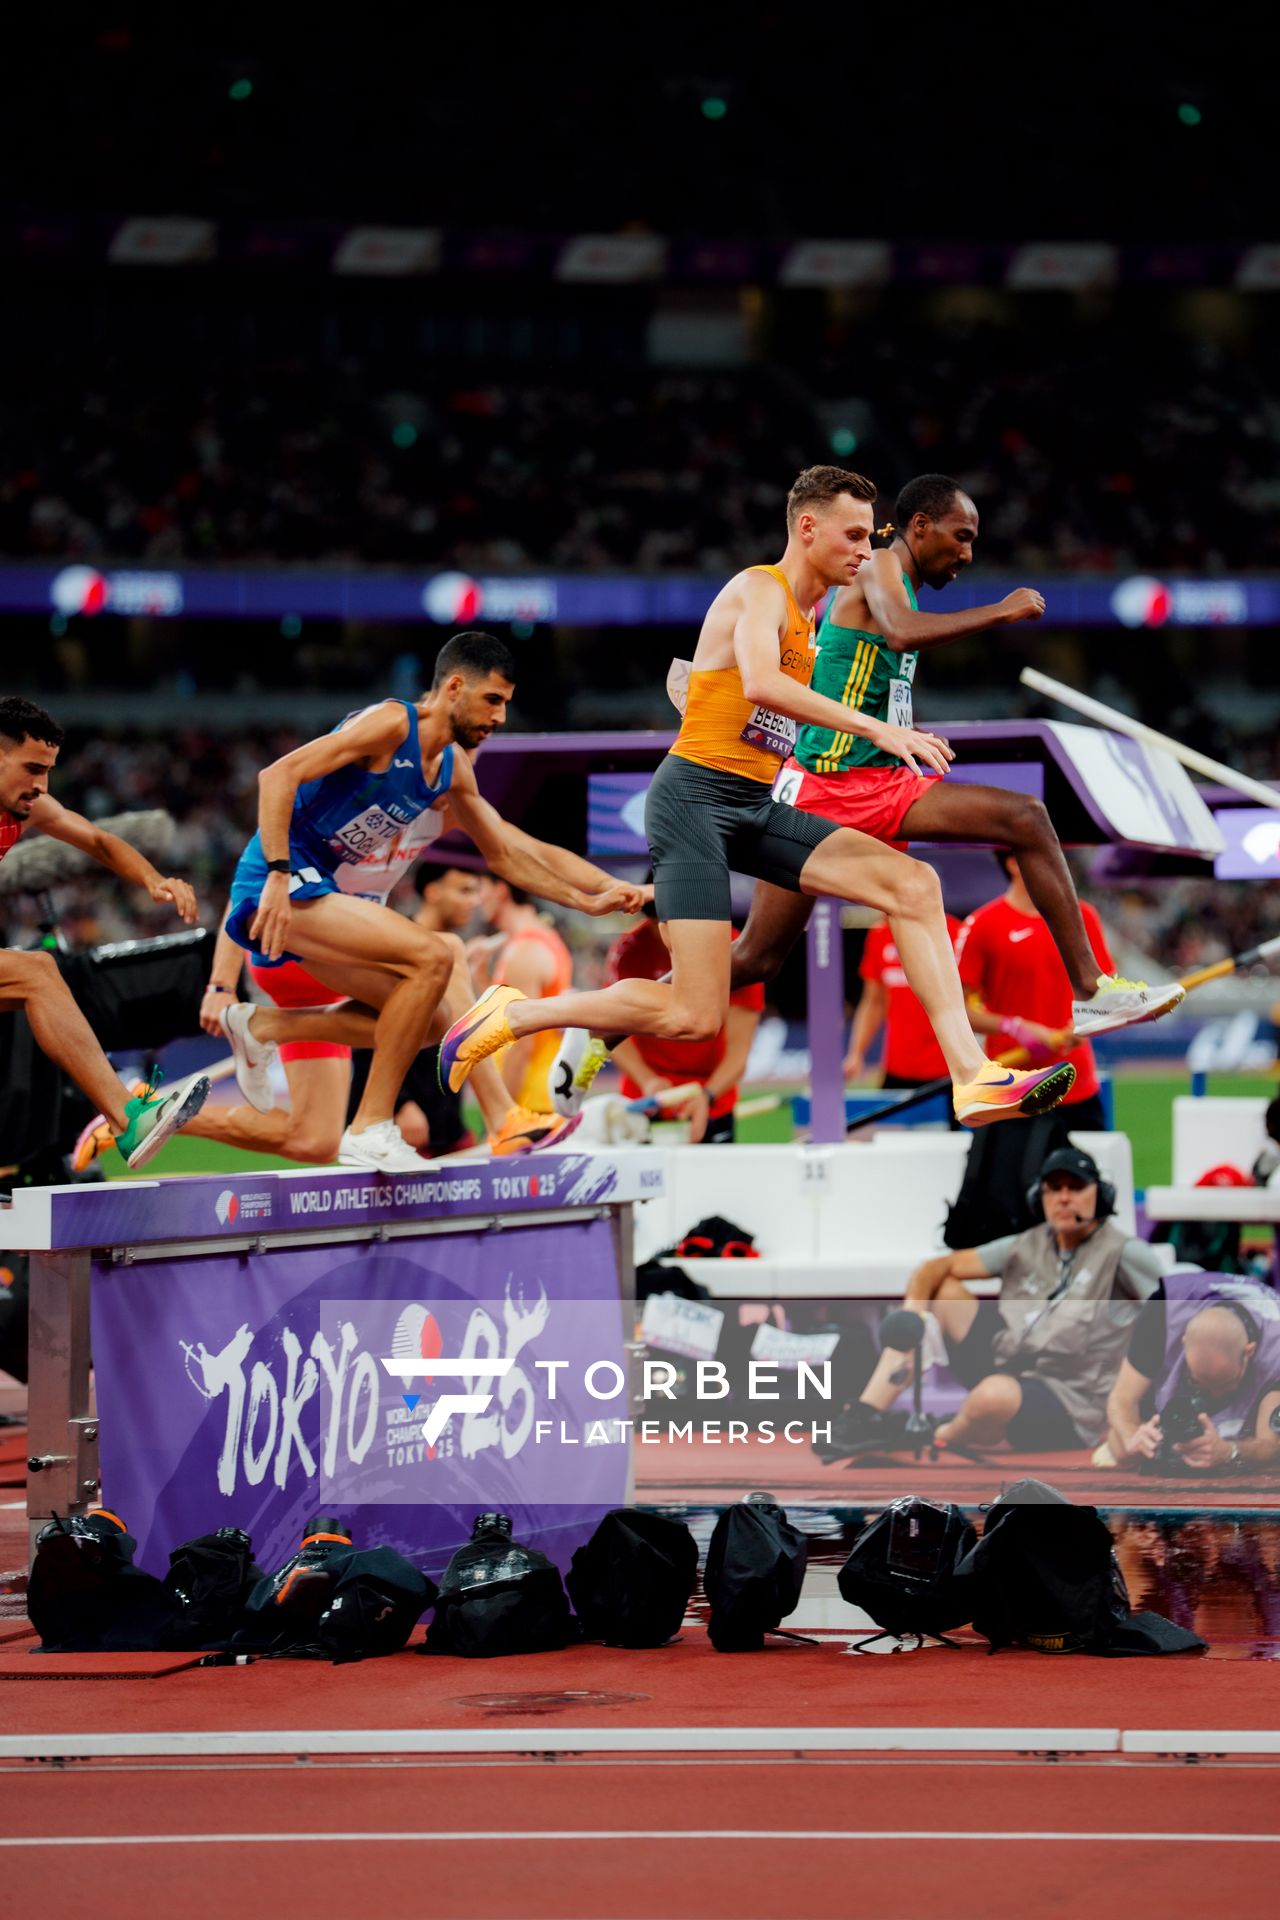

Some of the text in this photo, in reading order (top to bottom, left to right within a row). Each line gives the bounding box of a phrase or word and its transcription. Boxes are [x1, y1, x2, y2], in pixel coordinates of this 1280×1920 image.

[291, 1189, 330, 1214] WORLD
[333, 1186, 392, 1211] ATHLETICS
[394, 1178, 481, 1206] CHAMPIONSHIPS
[179, 1322, 379, 1497] TOKYO
